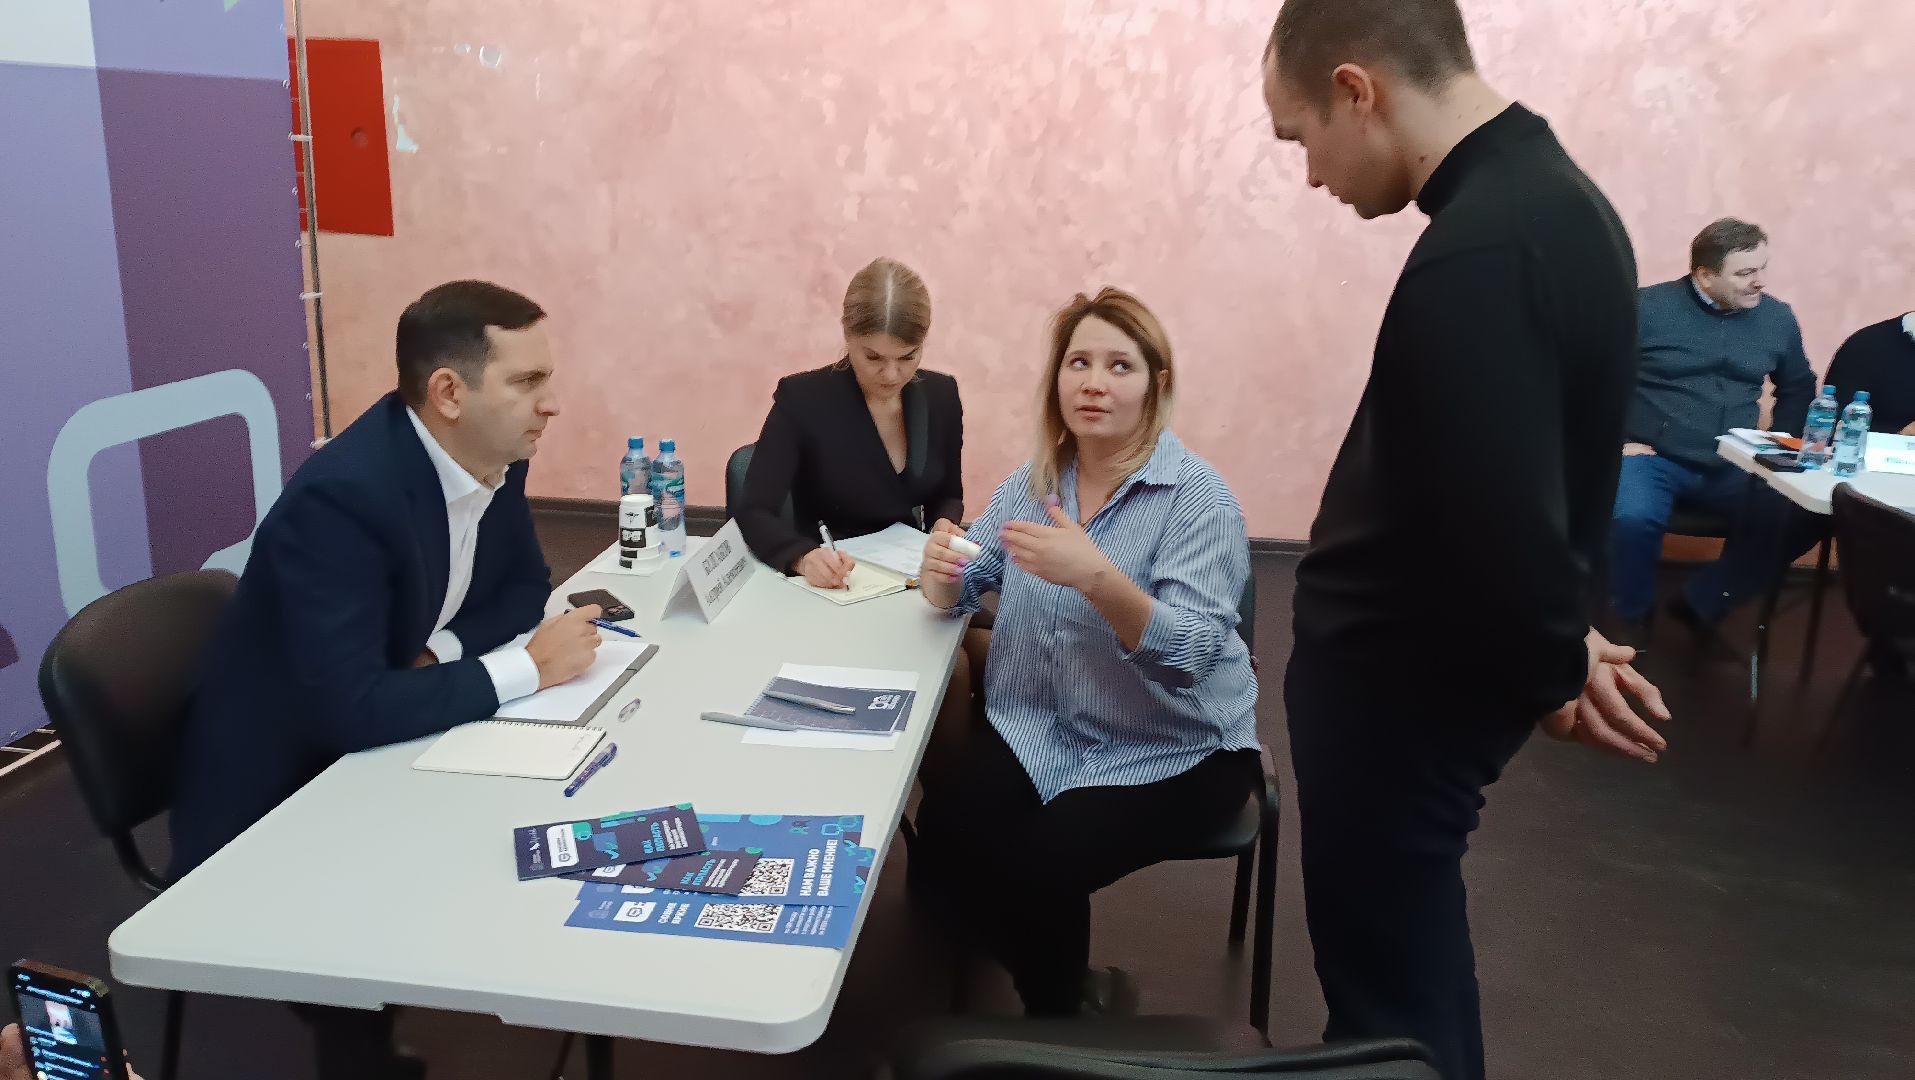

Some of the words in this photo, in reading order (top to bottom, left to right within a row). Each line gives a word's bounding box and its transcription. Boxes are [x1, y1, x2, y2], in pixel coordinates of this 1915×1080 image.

[804, 848, 820, 879] ВАЖНО
[800, 878, 814, 896] НАМ
[817, 873, 832, 896] ВАШЕ
